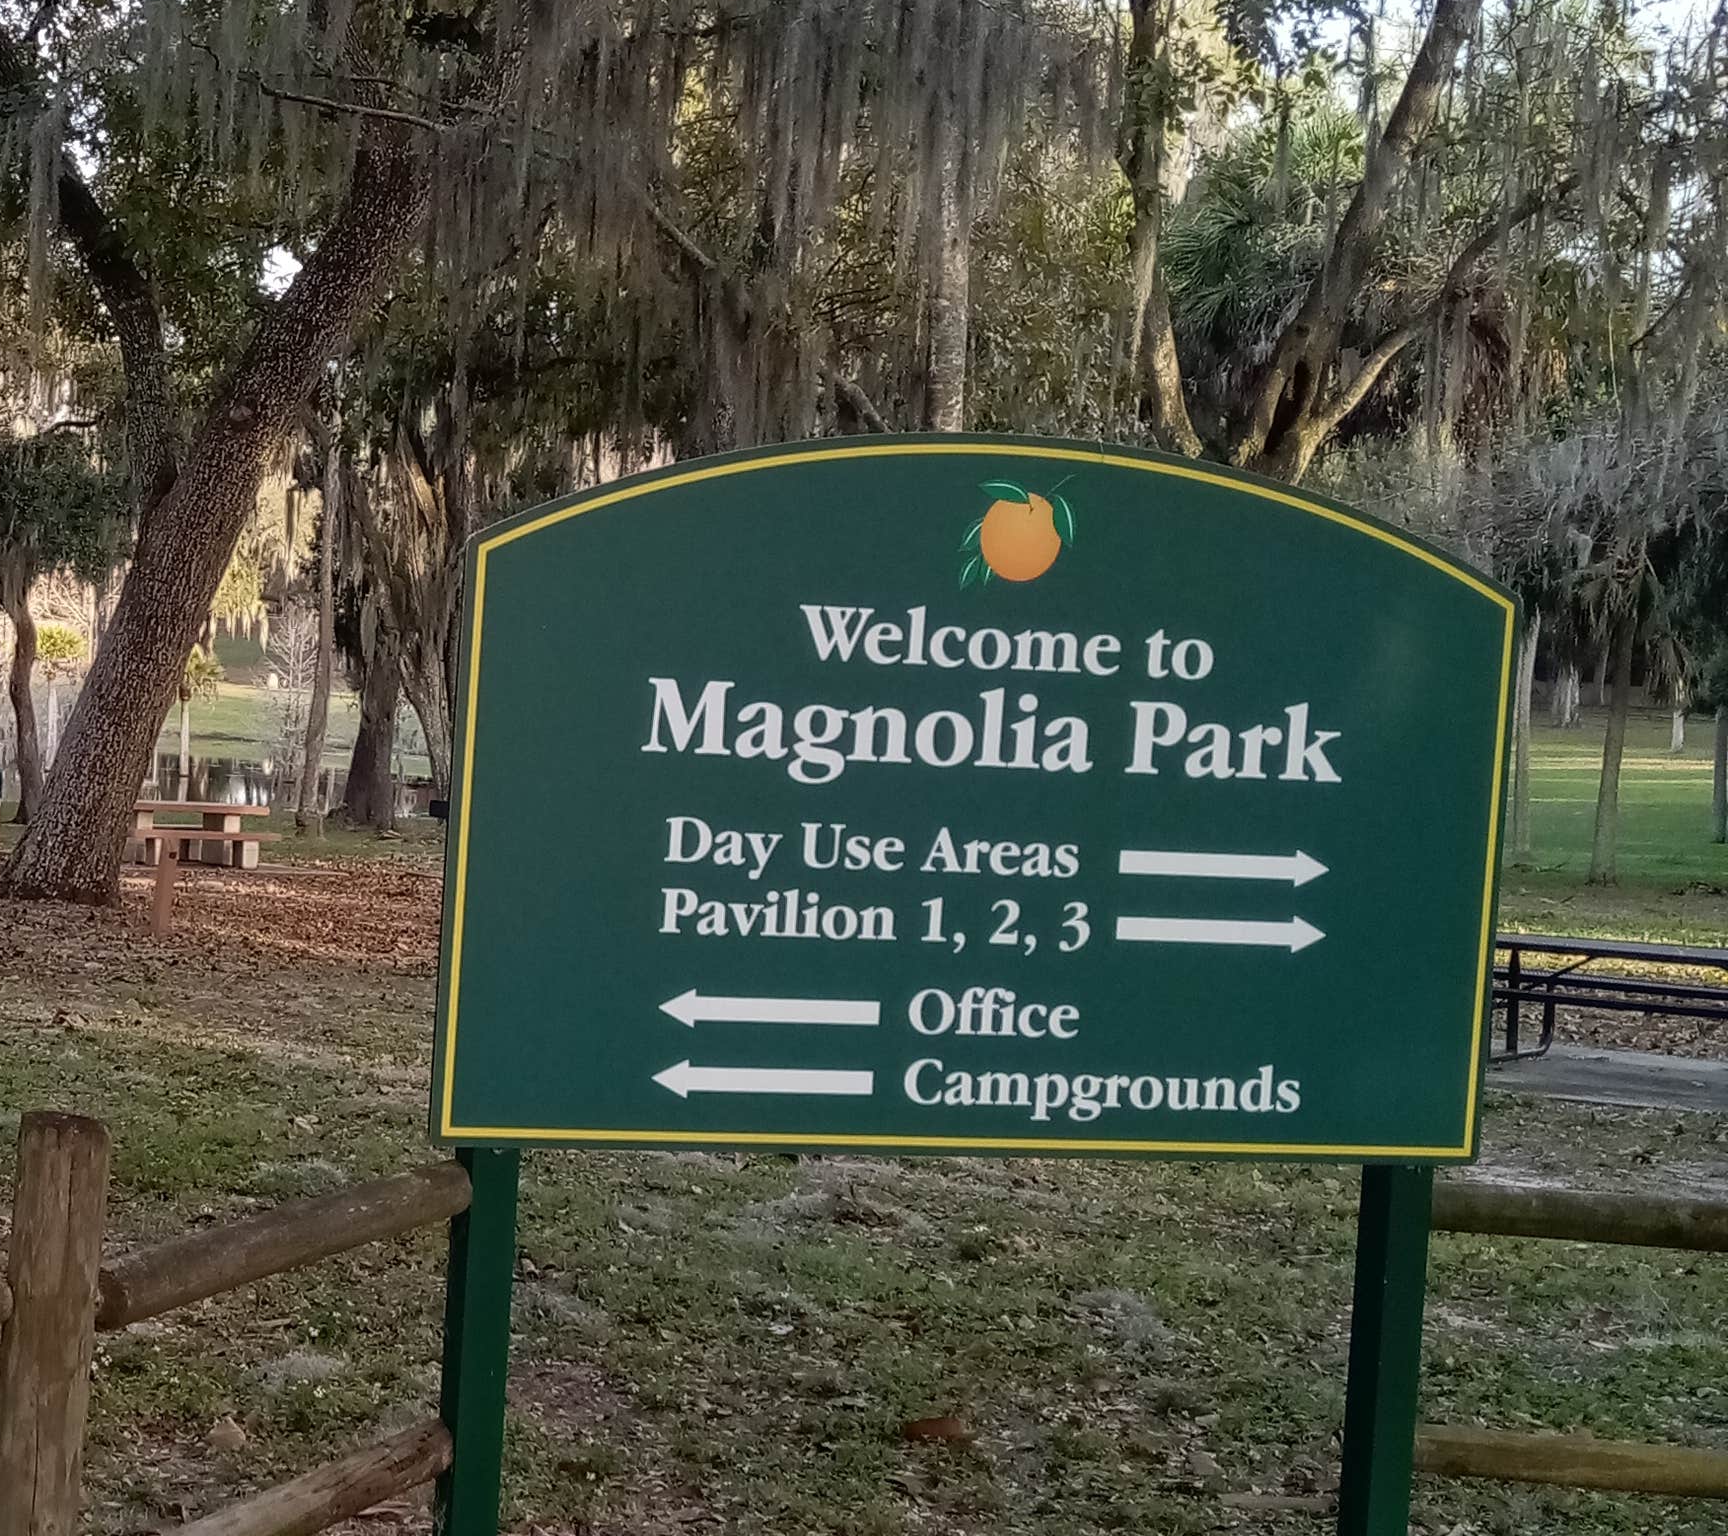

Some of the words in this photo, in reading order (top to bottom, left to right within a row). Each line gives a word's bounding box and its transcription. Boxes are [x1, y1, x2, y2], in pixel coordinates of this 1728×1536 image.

[799, 604, 1121, 676] Welcome
[1145, 629, 1214, 680] to
[641, 677, 1093, 784] Magnolia
[1124, 701, 1342, 783] Park
[663, 816, 783, 880] Day
[801, 822, 905, 871] Use
[920, 827, 1079, 878] Areas
[658, 888, 897, 940] Pavilion
[921, 897, 966, 953] 1,
[989, 899, 1037, 956] 2,
[1059, 901, 1090, 952] 3
[908, 986, 1080, 1039] Office
[904, 1058, 1300, 1121] Campgrounds
